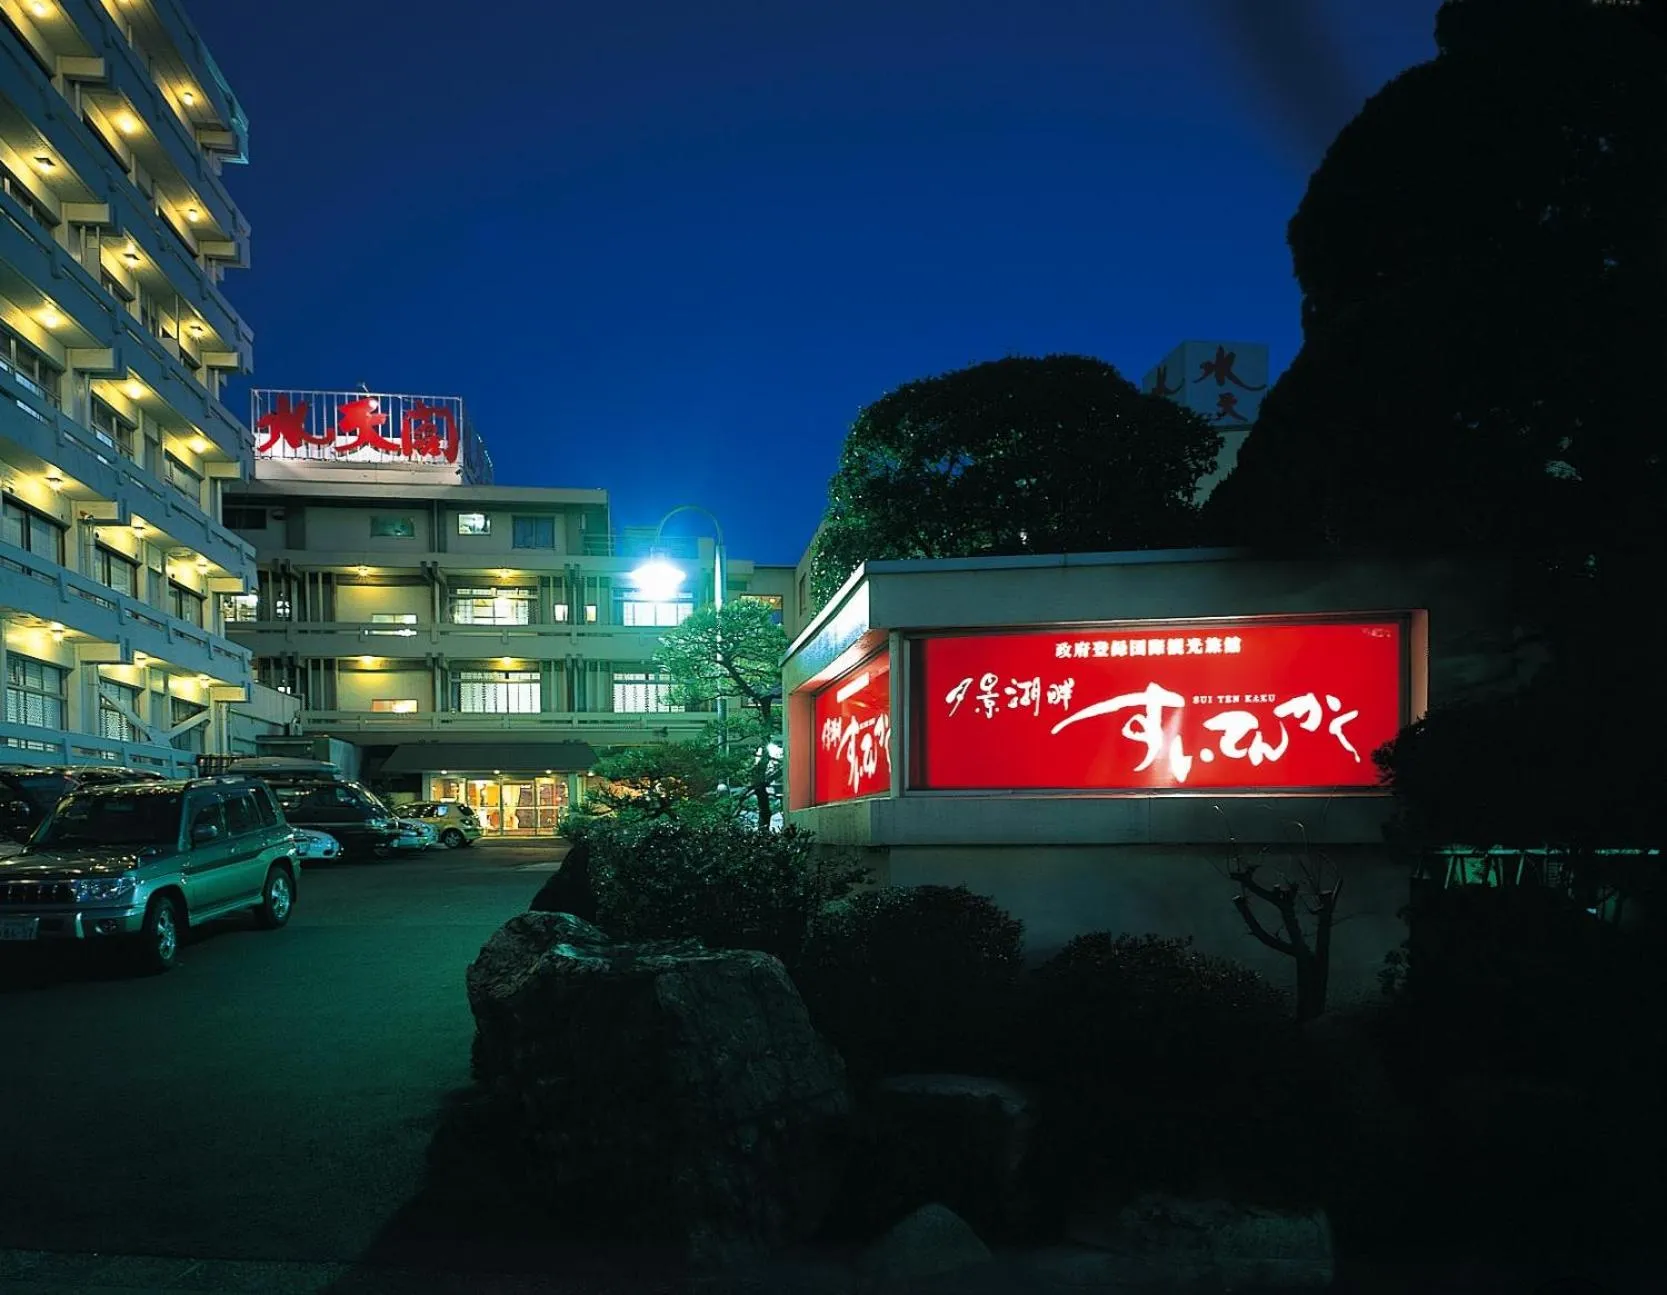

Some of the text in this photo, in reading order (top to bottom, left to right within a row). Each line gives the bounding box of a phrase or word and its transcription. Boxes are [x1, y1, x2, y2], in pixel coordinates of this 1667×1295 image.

[257, 393, 460, 464] 水天閣
[945, 672, 1075, 719] 夕景湖畔
[1193, 694, 1276, 704] SUI TEN KAKU
